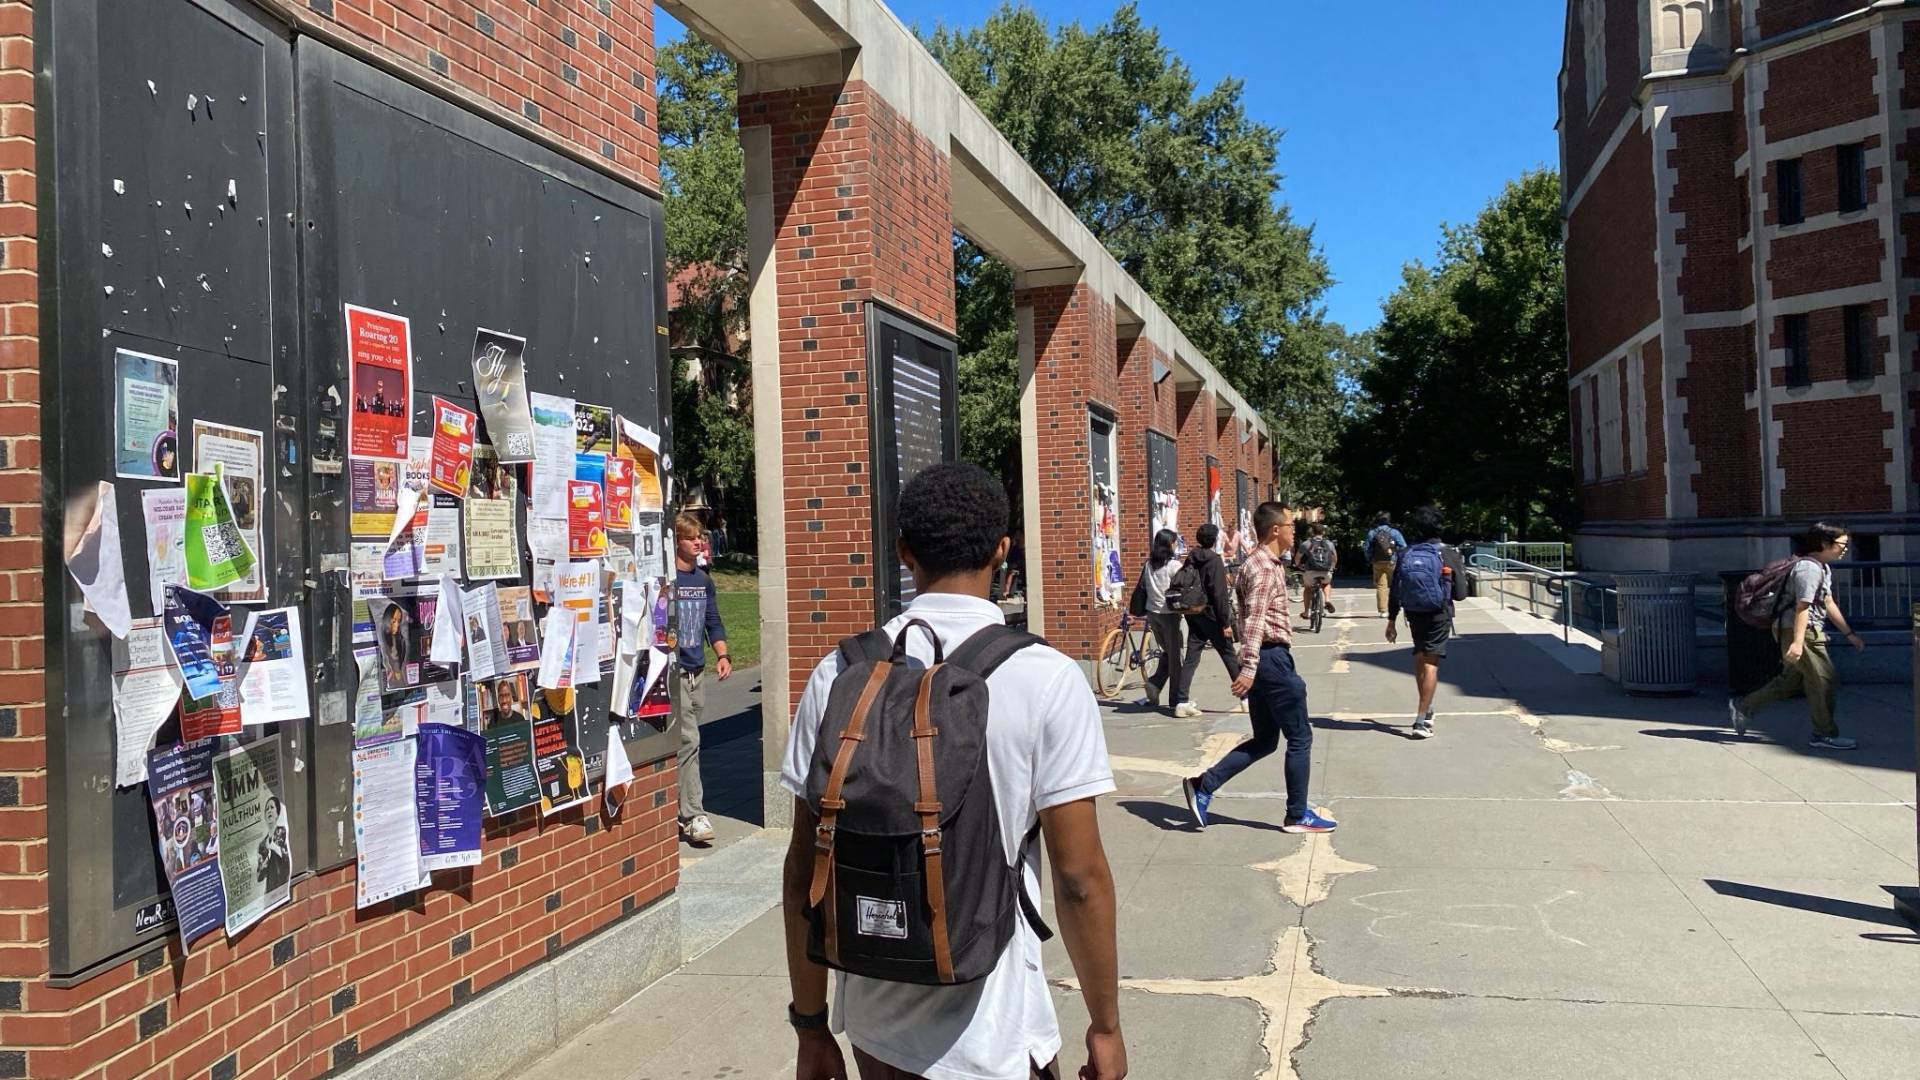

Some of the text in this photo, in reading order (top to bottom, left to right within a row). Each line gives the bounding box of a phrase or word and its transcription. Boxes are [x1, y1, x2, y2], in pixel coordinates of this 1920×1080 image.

[359, 327, 399, 345] Roaring 20
[371, 353, 385, 362] your
[575, 411, 586, 419] ASS
[405, 471, 430, 480] BOOKS
[222, 802, 261, 829] KULTHUM
[865, 906, 898, 920] Herschel
